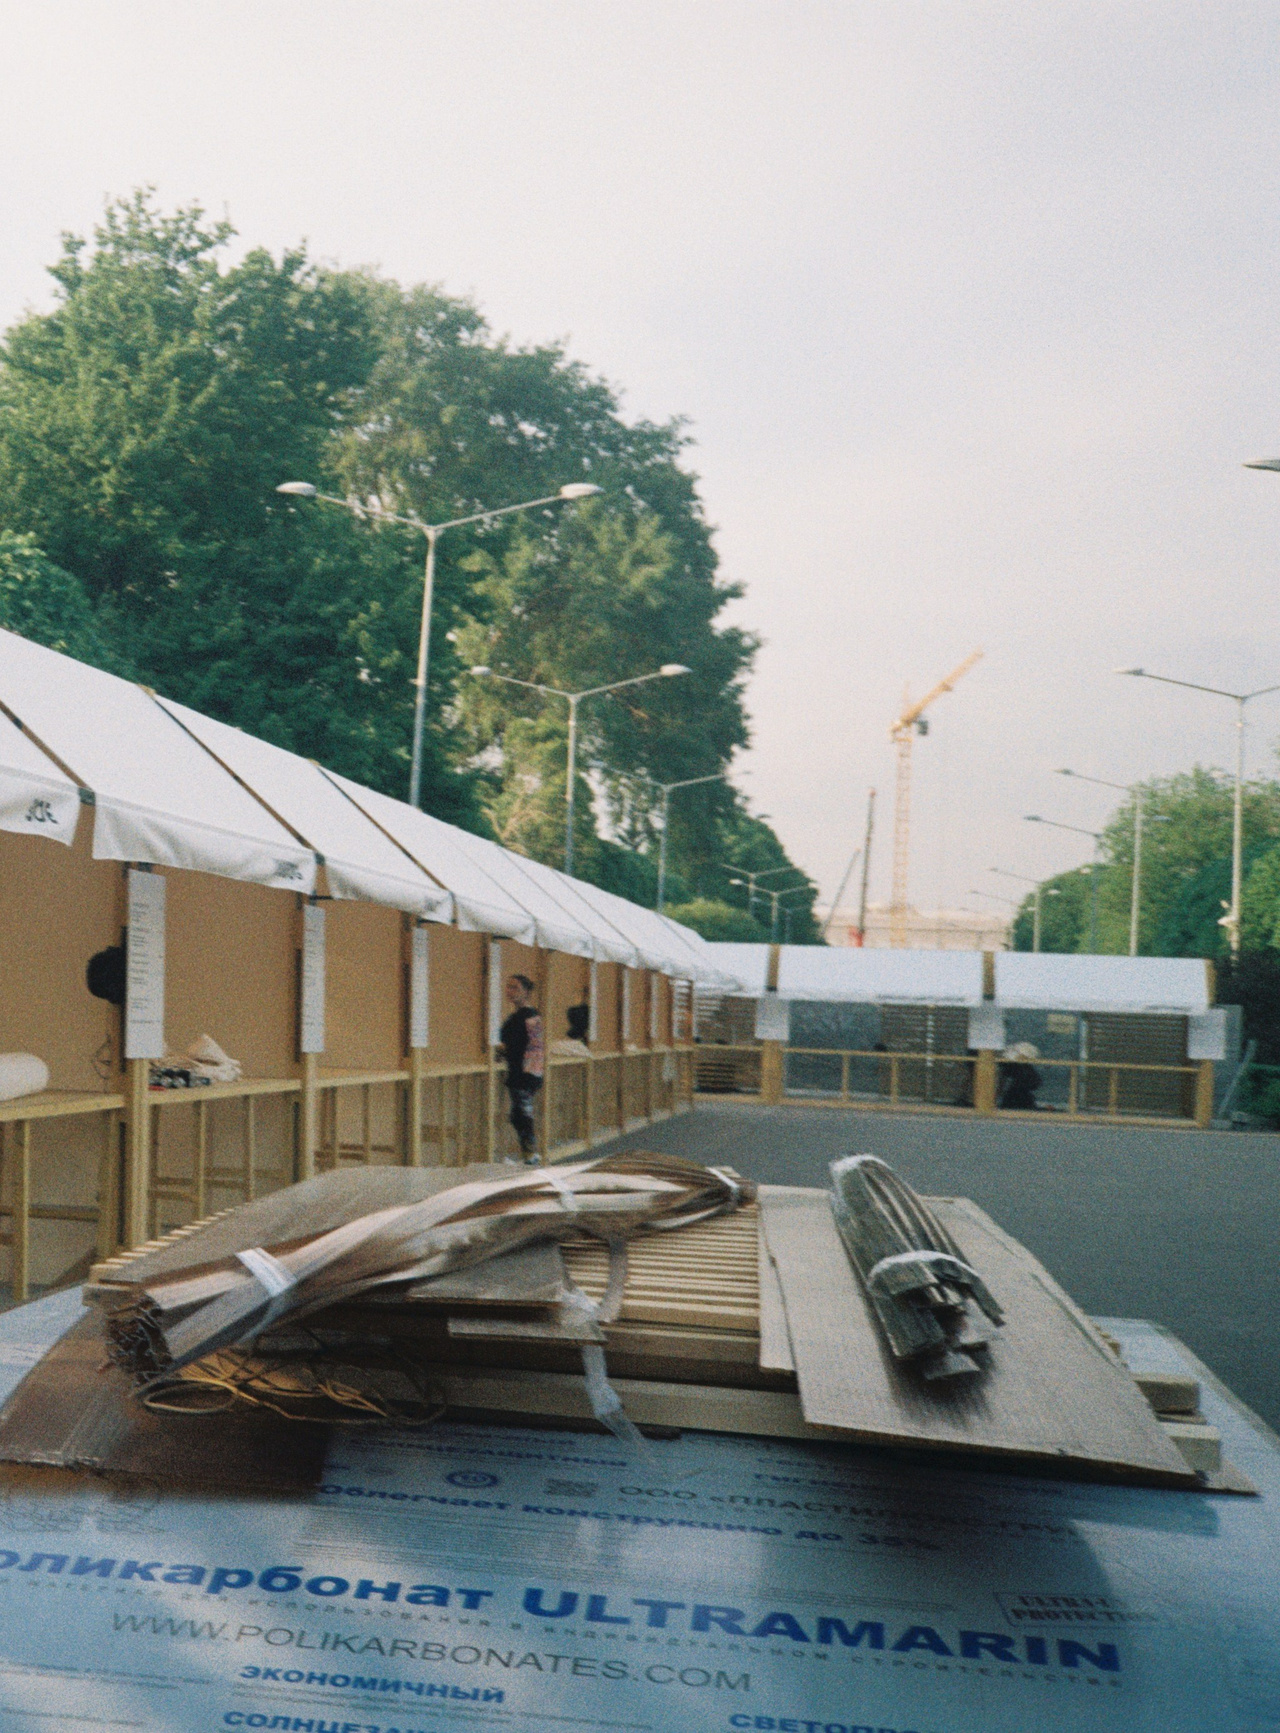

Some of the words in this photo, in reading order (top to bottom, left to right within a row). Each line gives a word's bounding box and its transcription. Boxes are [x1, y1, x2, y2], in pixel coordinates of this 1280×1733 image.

[321, 1484, 511, 1511] Облегчает
[522, 1504, 783, 1536] конструкцию
[794, 1529, 842, 1545] до
[617, 1485, 699, 1501] ООО
[112, 1613, 751, 1691] WWW.POLIKARBONATES.COM
[521, 1587, 1121, 1672] ULTRAMARIN
[239, 1665, 506, 1703] ЭКОНОМИЧНЫЙ
